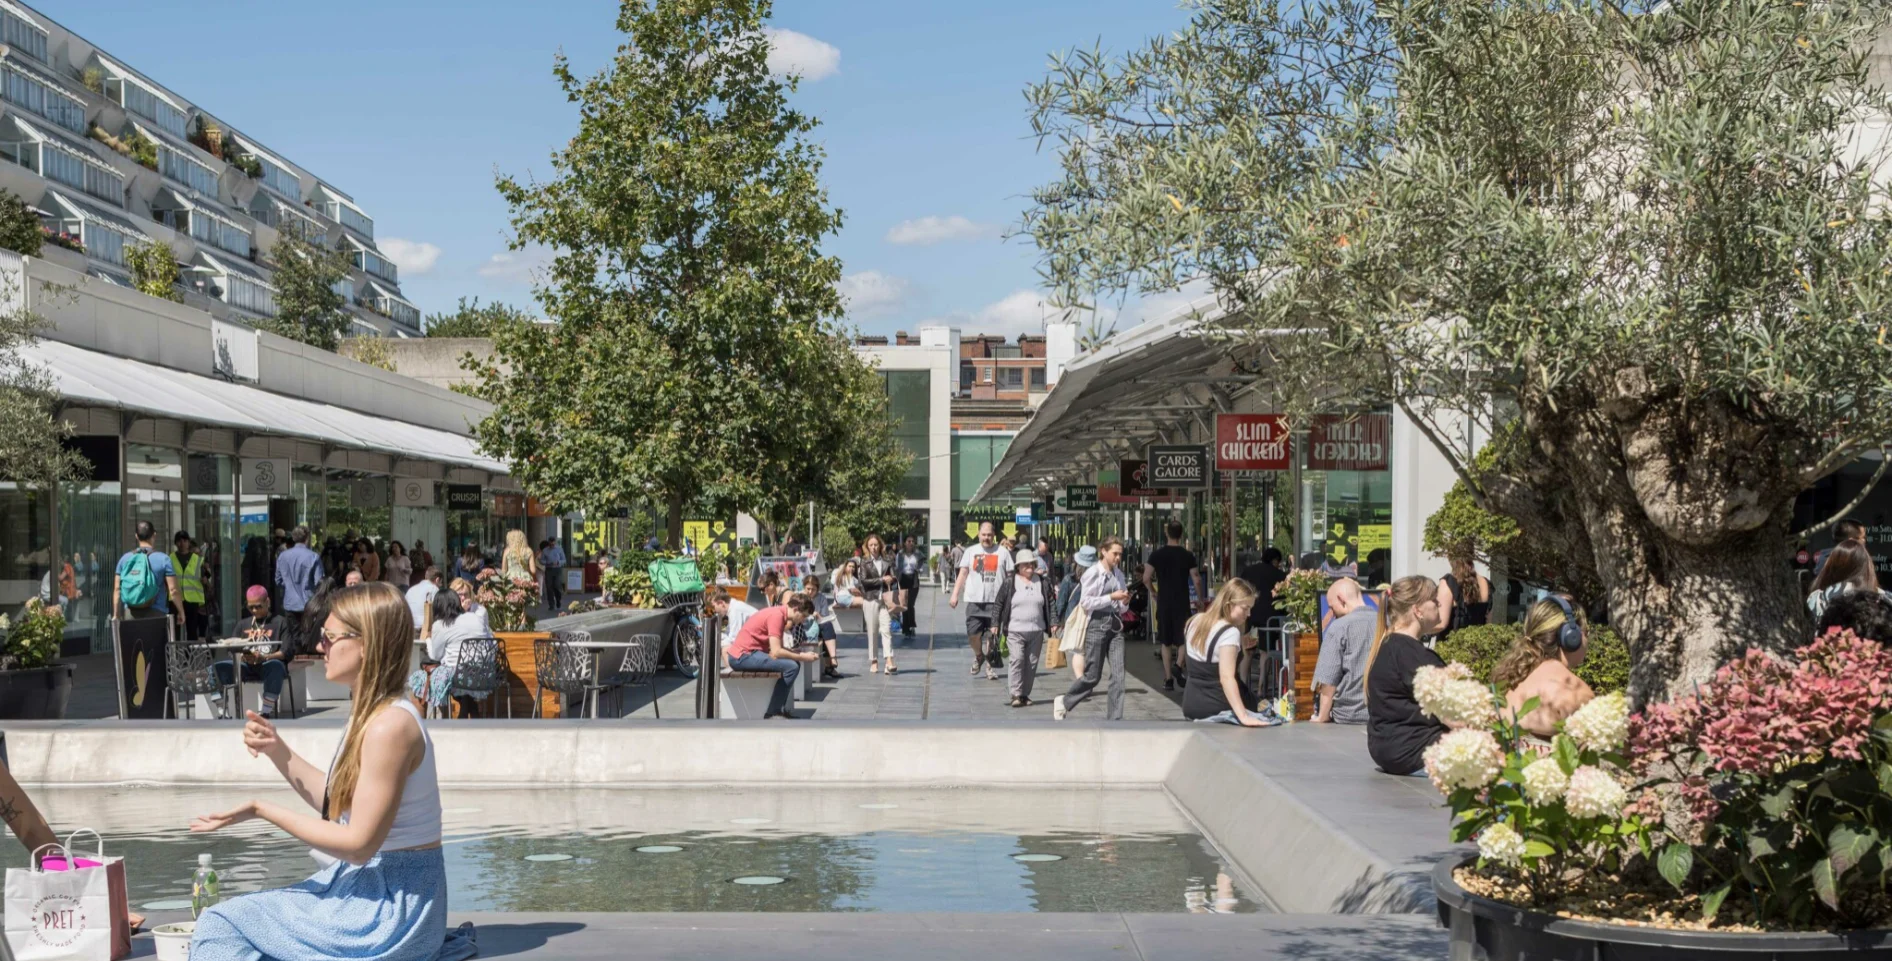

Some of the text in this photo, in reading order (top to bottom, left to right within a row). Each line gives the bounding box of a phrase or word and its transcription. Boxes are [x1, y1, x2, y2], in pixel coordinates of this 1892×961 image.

[1236, 422, 1270, 441] SLIM
[1221, 442, 1285, 460] CHICKENS
[1158, 455, 1198, 466] CARDS
[255, 461, 275, 488] 3
[1155, 466, 1201, 478] GALORE
[962, 505, 1017, 515] WAITROS
[1071, 500, 1096, 508] BARRETT
[43, 910, 74, 930] PRET
